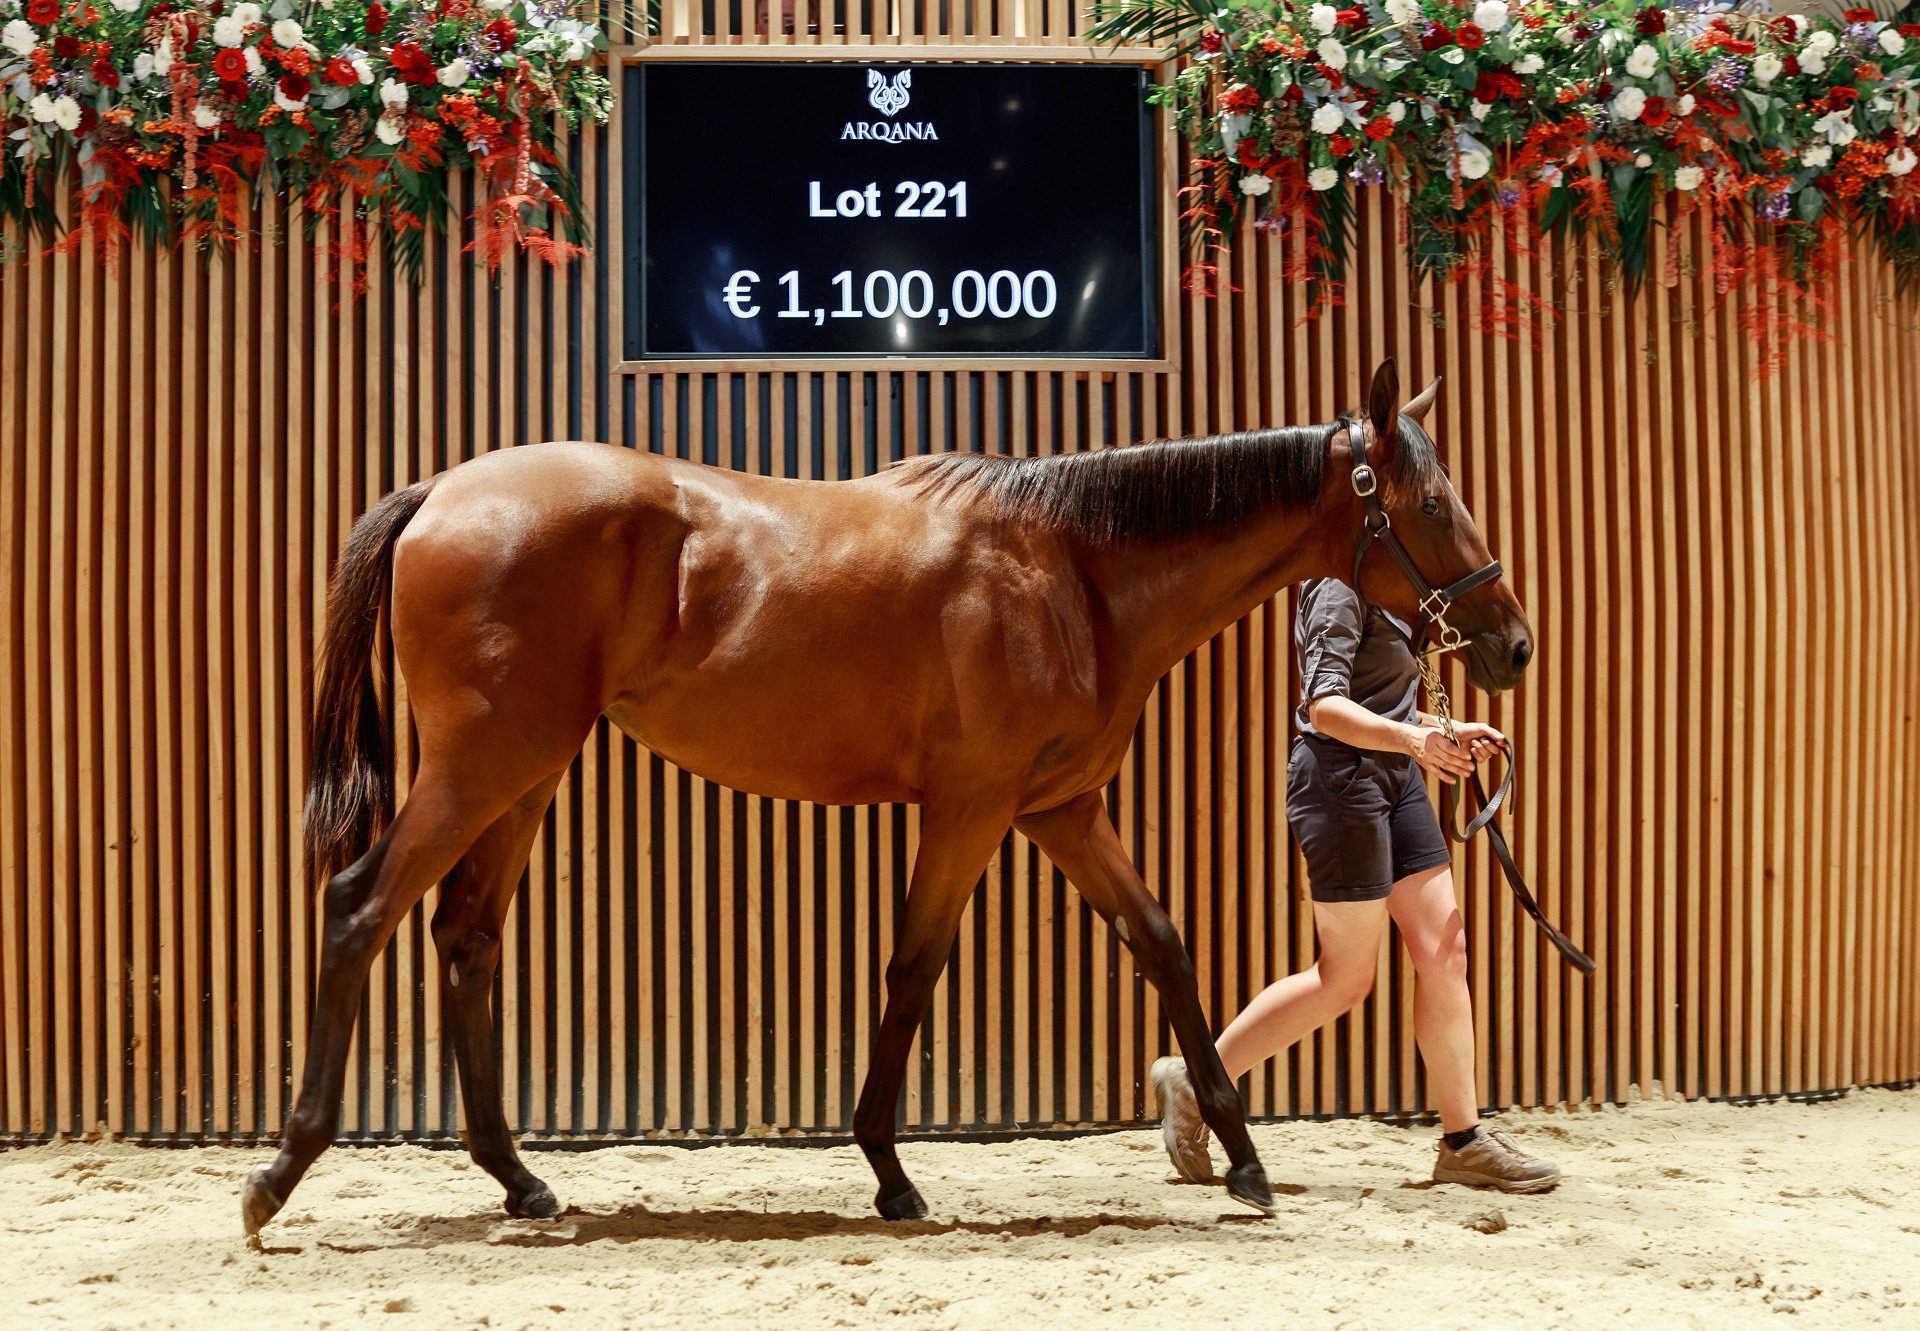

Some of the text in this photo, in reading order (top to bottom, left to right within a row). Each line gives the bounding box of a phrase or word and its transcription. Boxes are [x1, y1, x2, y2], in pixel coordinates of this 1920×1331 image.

[840, 121, 939, 144] ARQANA
[809, 180, 967, 218] Lot 221
[722, 269, 1058, 326] € 1,100,000
